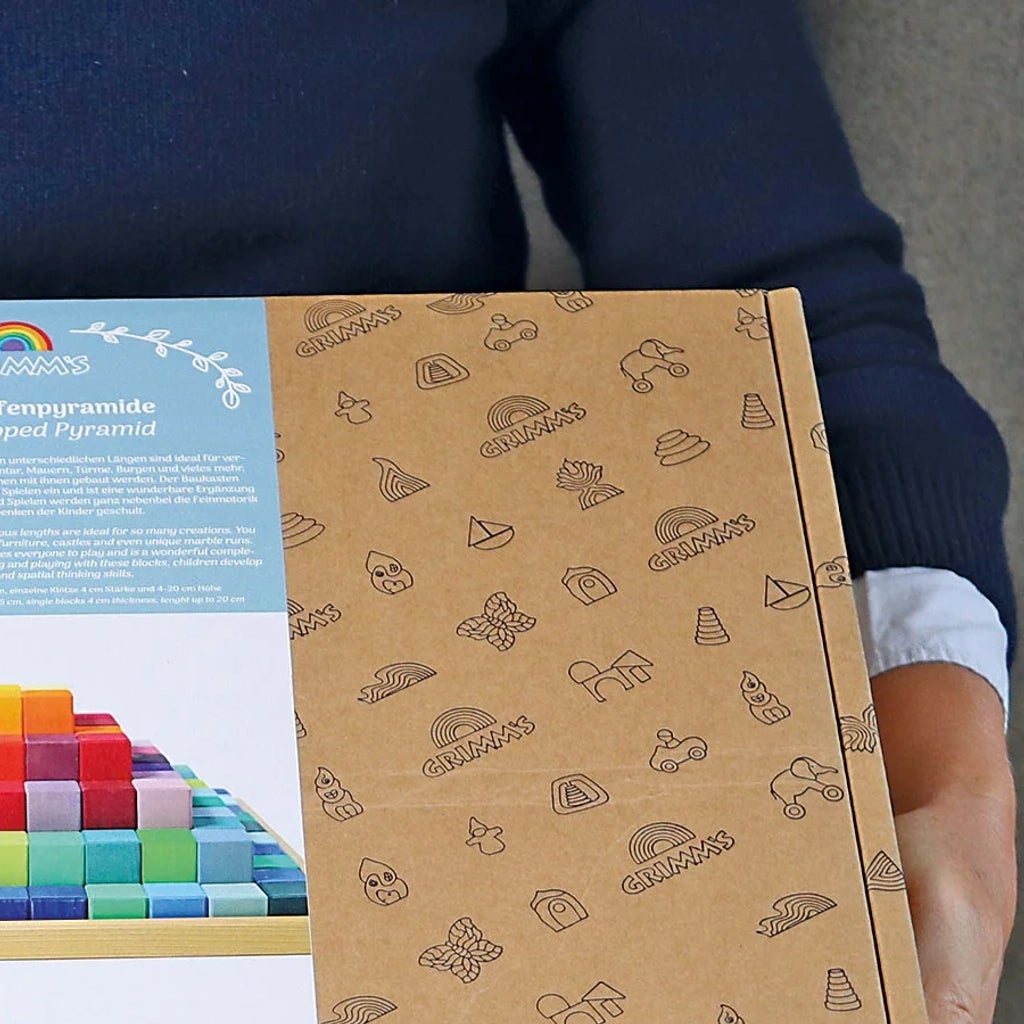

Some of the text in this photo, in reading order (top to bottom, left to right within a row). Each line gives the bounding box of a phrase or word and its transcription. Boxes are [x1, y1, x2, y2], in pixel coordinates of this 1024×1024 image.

[296, 305, 402, 357] GRIMM'S
[55, 420, 157, 440] Pyramid
[480, 403, 586, 459] GRIMM'S
[8, 455, 104, 464] unterschiedlichen
[107, 454, 146, 465] Längen
[148, 454, 172, 462] sind
[174, 454, 200, 462] ideal
[202, 453, 219, 462] für
[222, 454, 246, 462] ver-
[116, 464, 155, 475] Burgen
[157, 464, 178, 473] und
[180, 464, 211, 472] vieles
[39, 476, 70, 484] ihnen
[72, 475, 109, 486] gebaut
[159, 474, 178, 483] Der
[181, 474, 239, 483] Baukasten
[1, 487, 41, 497] Spielen
[43, 486, 60, 495] ein
[62, 486, 83, 495] und
[101, 486, 123, 494] eine
[126, 485, 193, 494] wunderbare
[196, 484, 255, 495] Ergänzung
[6, 497, 46, 508] Spielen
[48, 496, 90, 505] werden
[92, 498, 120, 507] ganz
[122, 495, 171, 504] nebenbei
[173, 495, 190, 504] die
[192, 494, 258, 503] Feinmotorik
[36, 507, 55, 516] der
[58, 507, 93, 516] Kinder
[19, 528, 60, 538] lengths
[82, 527, 110, 536] ideal
[111, 527, 128, 535] for
[144, 528, 178, 537] many
[235, 525, 256, 534] You
[52, 538, 92, 547] castles
[92, 537, 115, 546] and
[144, 536, 182, 547] unique
[183, 536, 223, 545] marble
[648, 514, 756, 571] GRIMM'S
[13, 550, 66, 560] everyone
[80, 548, 105, 559] play
[106, 548, 128, 557] and
[150, 547, 209, 556] wonderful
[209, 546, 255, 557] comple-
[6, 560, 29, 569] and
[29, 560, 72, 570] playing
[72, 559, 98, 568] with
[98, 559, 130, 567] these
[172, 558, 218, 566] children
[219, 557, 264, 568] develop
[16, 570, 55, 581] spatial
[55, 569, 102, 580] thinking
[422, 715, 535, 778] GRIMM'S
[621, 830, 735, 894] GRIMM'S
